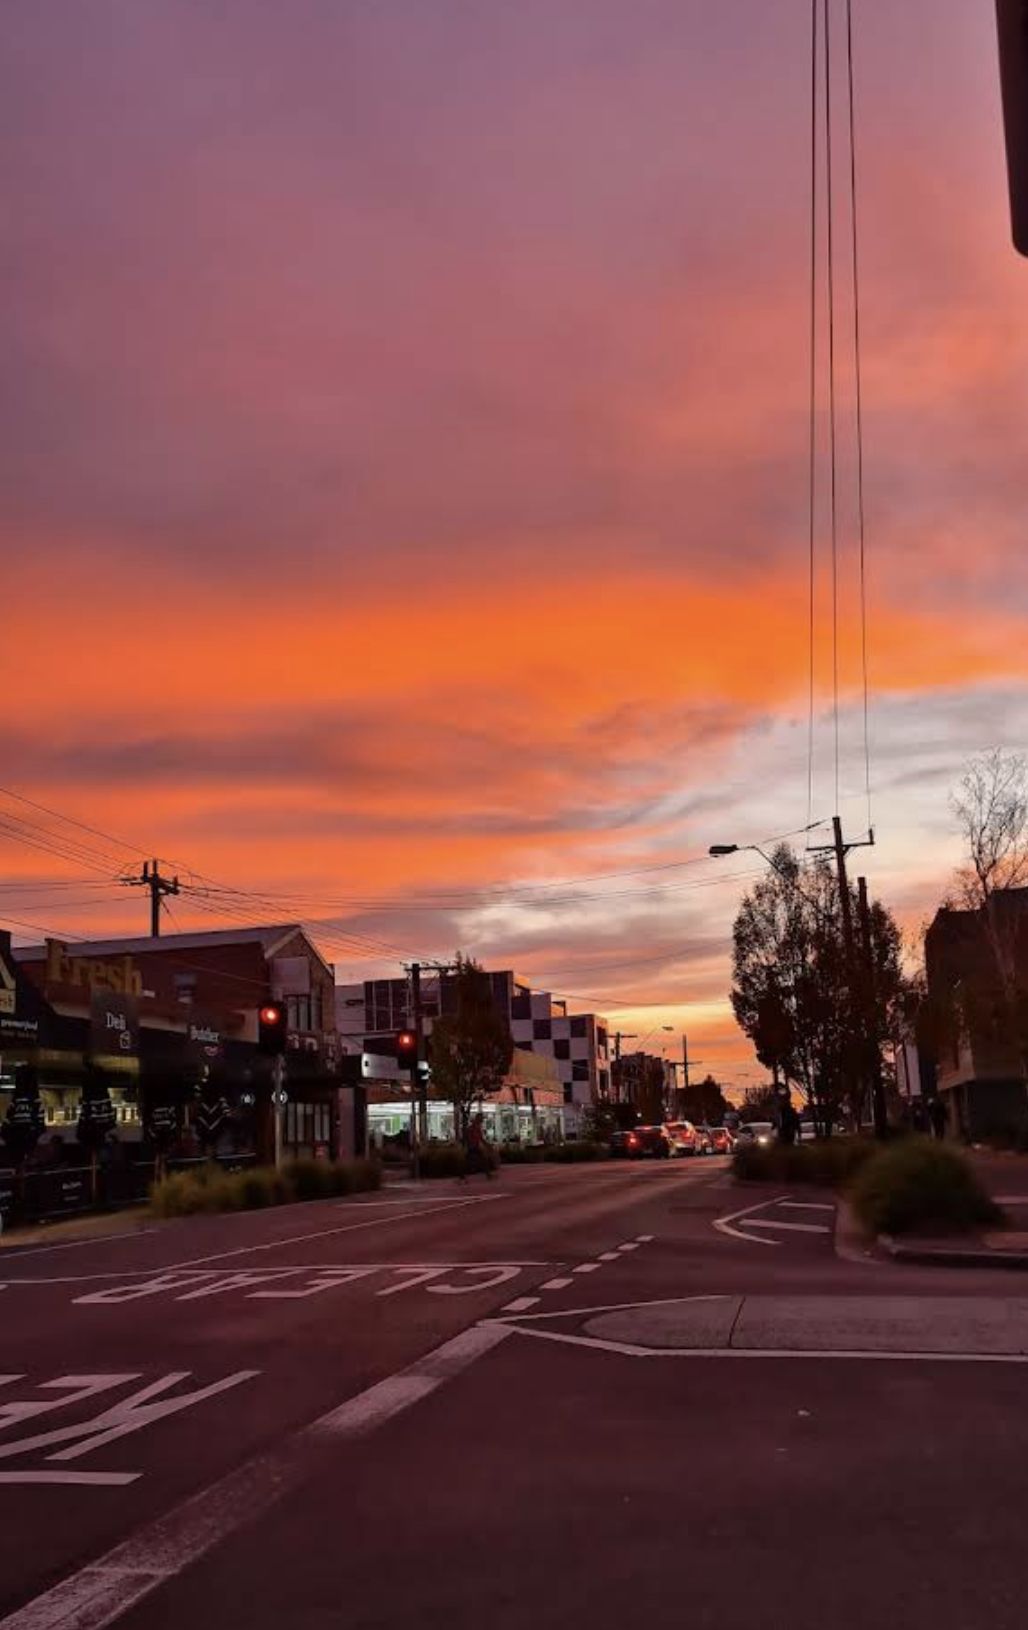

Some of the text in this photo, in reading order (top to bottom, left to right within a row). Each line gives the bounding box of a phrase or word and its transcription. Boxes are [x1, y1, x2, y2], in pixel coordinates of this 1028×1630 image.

[46, 939, 141, 997] Fresh
[105, 1011, 126, 1031] Deli
[71, 1265, 521, 1304] CLEAR
